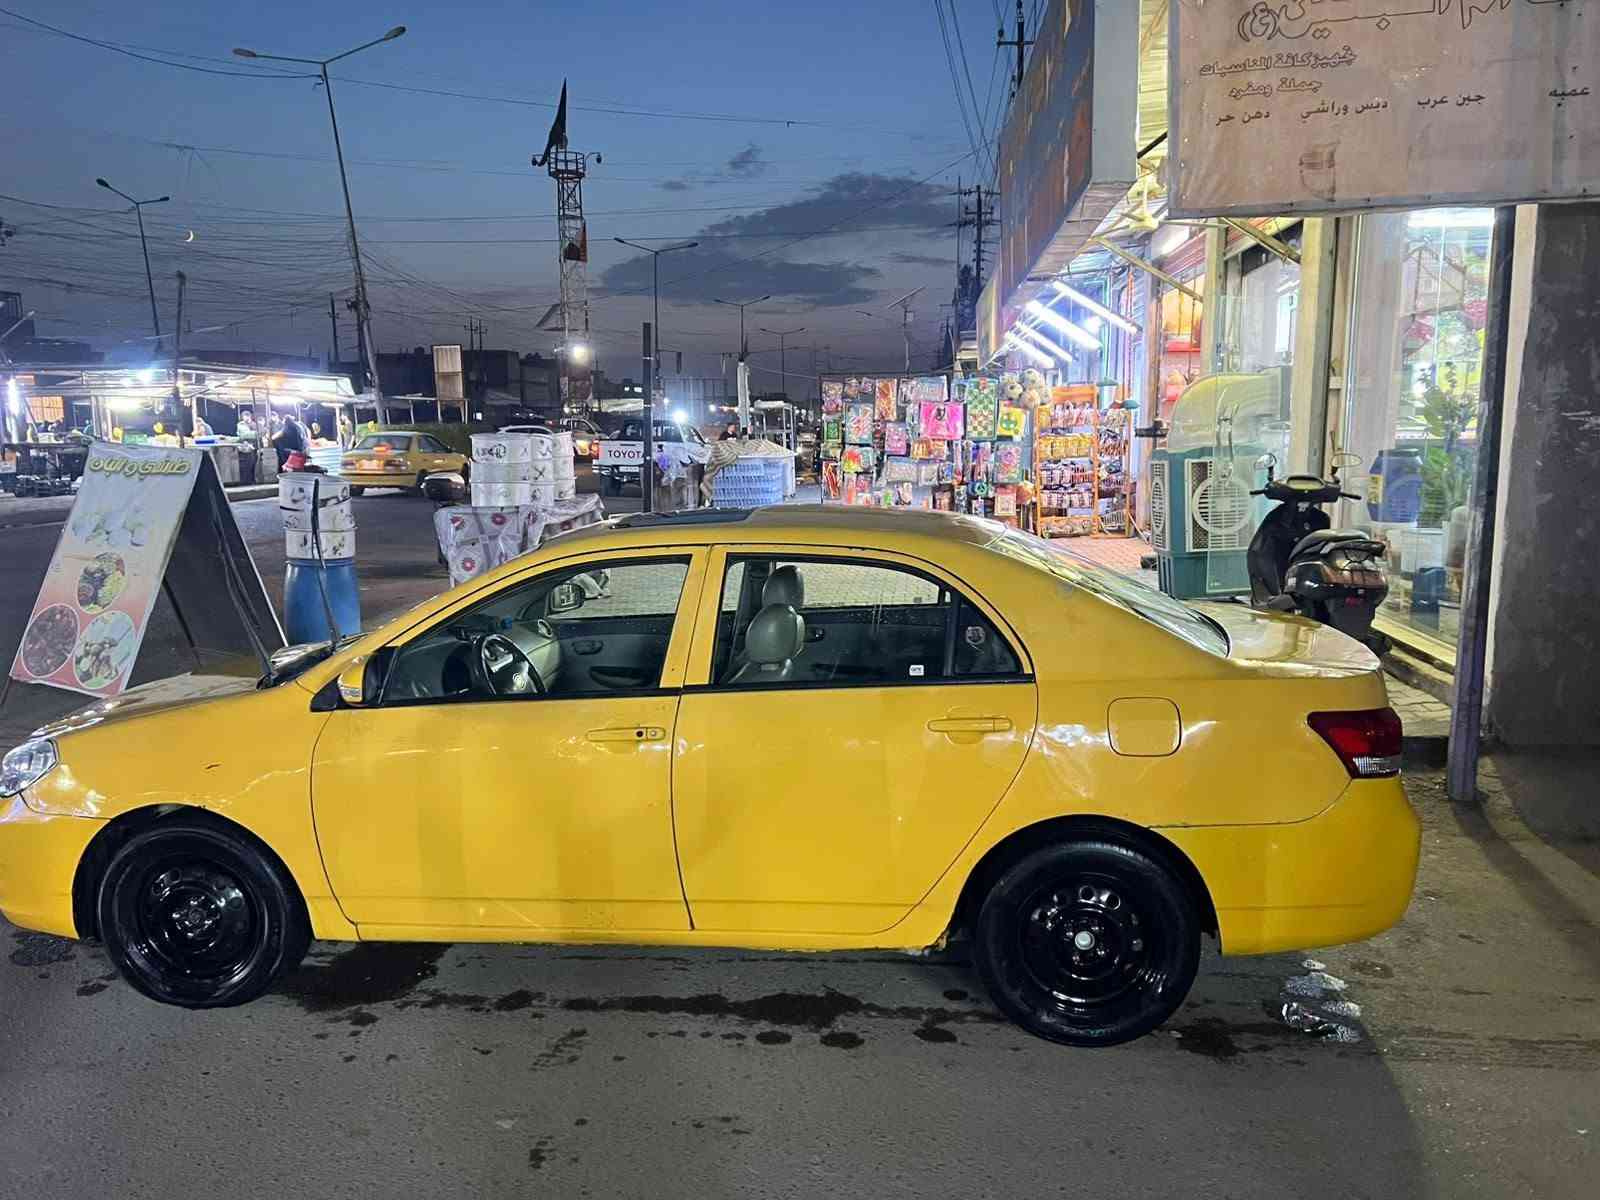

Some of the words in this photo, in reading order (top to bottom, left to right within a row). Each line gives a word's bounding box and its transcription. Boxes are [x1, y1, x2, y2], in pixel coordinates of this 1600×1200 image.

[1276, 77, 1323, 93] جملة
[1355, 98, 1389, 113] دبس
[1416, 95, 1449, 108] عرب
[1455, 92, 1486, 106] جبن
[1215, 114, 1236, 126] حر
[1241, 109, 1271, 124] دهن
